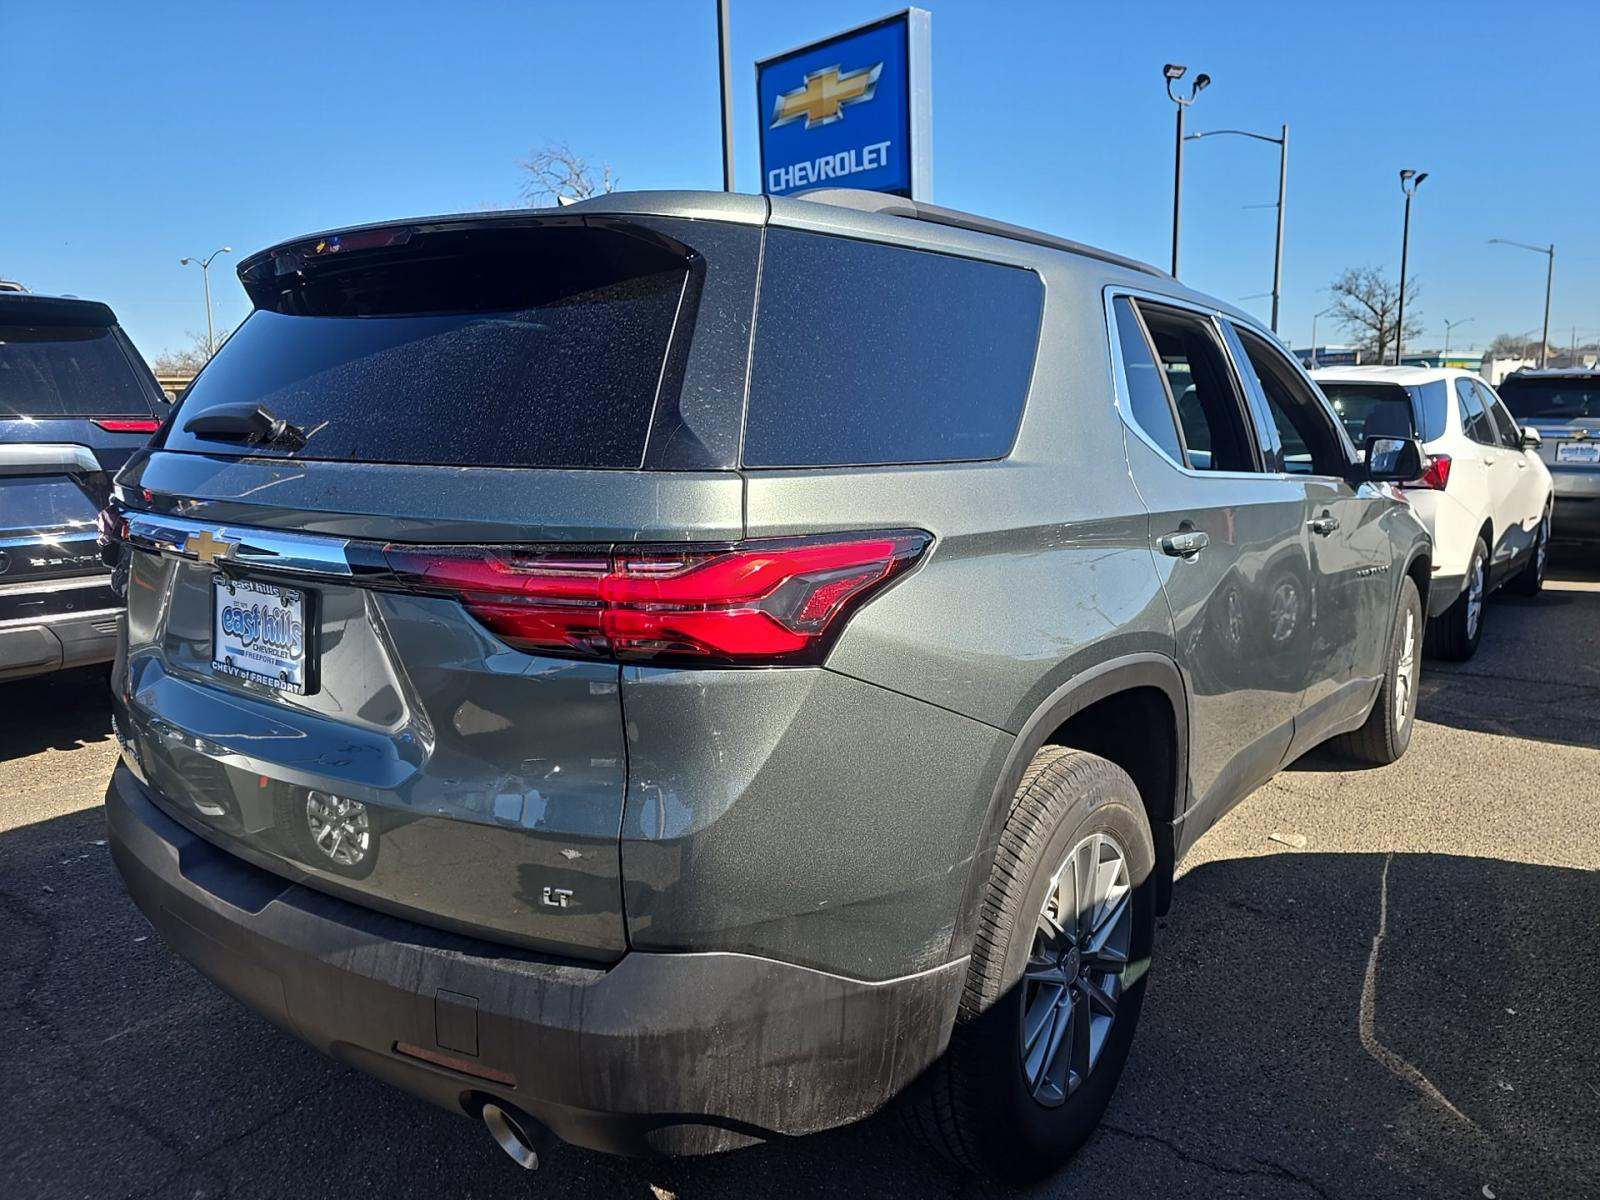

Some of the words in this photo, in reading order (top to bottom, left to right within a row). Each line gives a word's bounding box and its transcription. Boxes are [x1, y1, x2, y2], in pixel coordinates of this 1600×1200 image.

[769, 141, 891, 192] CHEVROLET
[232, 580, 254, 591] east
[255, 584, 280, 595] hills
[222, 604, 260, 647] east
[261, 605, 303, 659] hills
[245, 651, 276, 664] FREEPORT
[253, 644, 288, 659] CHEVROLET
[212, 661, 239, 677] CHEVY
[543, 886, 573, 907] LT
